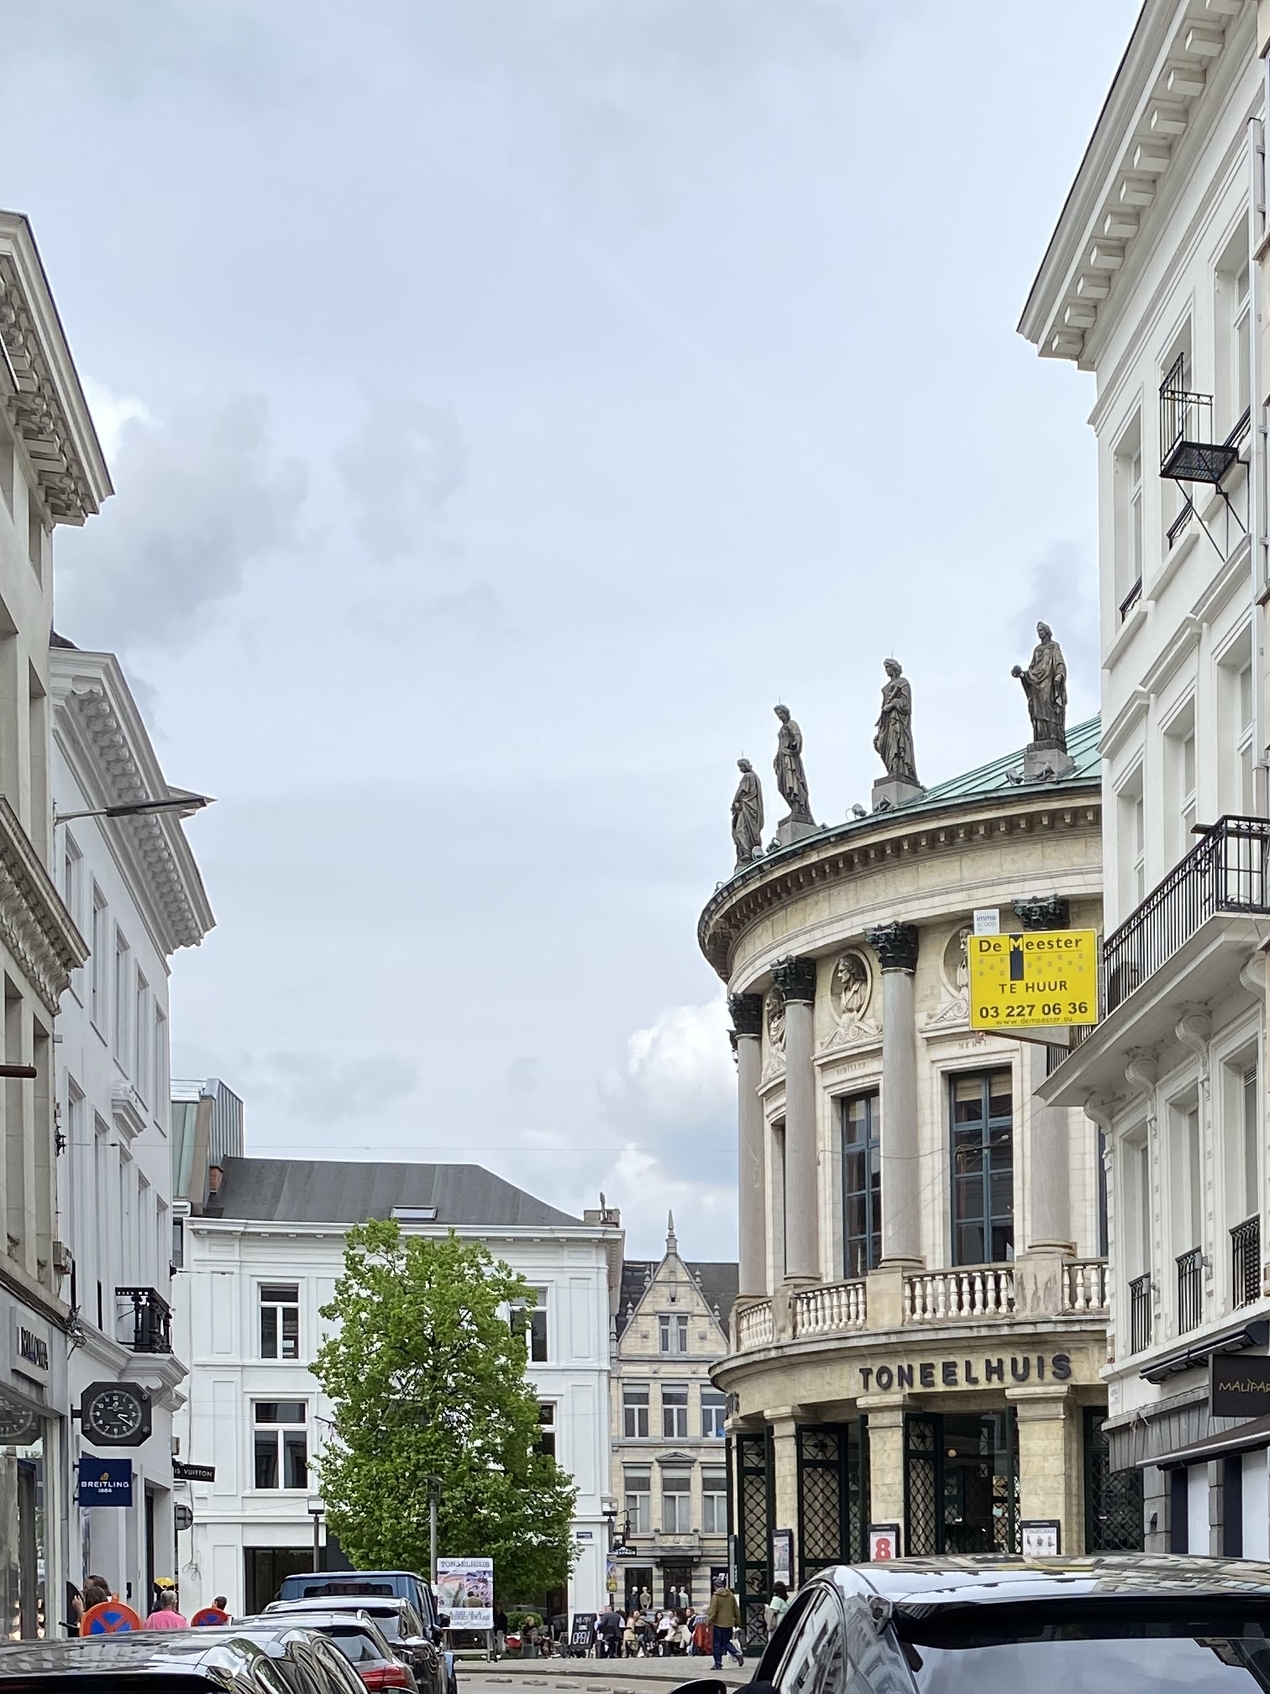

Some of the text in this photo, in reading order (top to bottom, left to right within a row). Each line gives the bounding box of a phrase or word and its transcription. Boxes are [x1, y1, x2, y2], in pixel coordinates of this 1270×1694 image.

[979, 936, 1083, 953] De Meester
[998, 980, 1068, 995] TE HUUR
[979, 1001, 1088, 1019] 03 227 06 36
[858, 1353, 1073, 1392] TONEELHUIS
